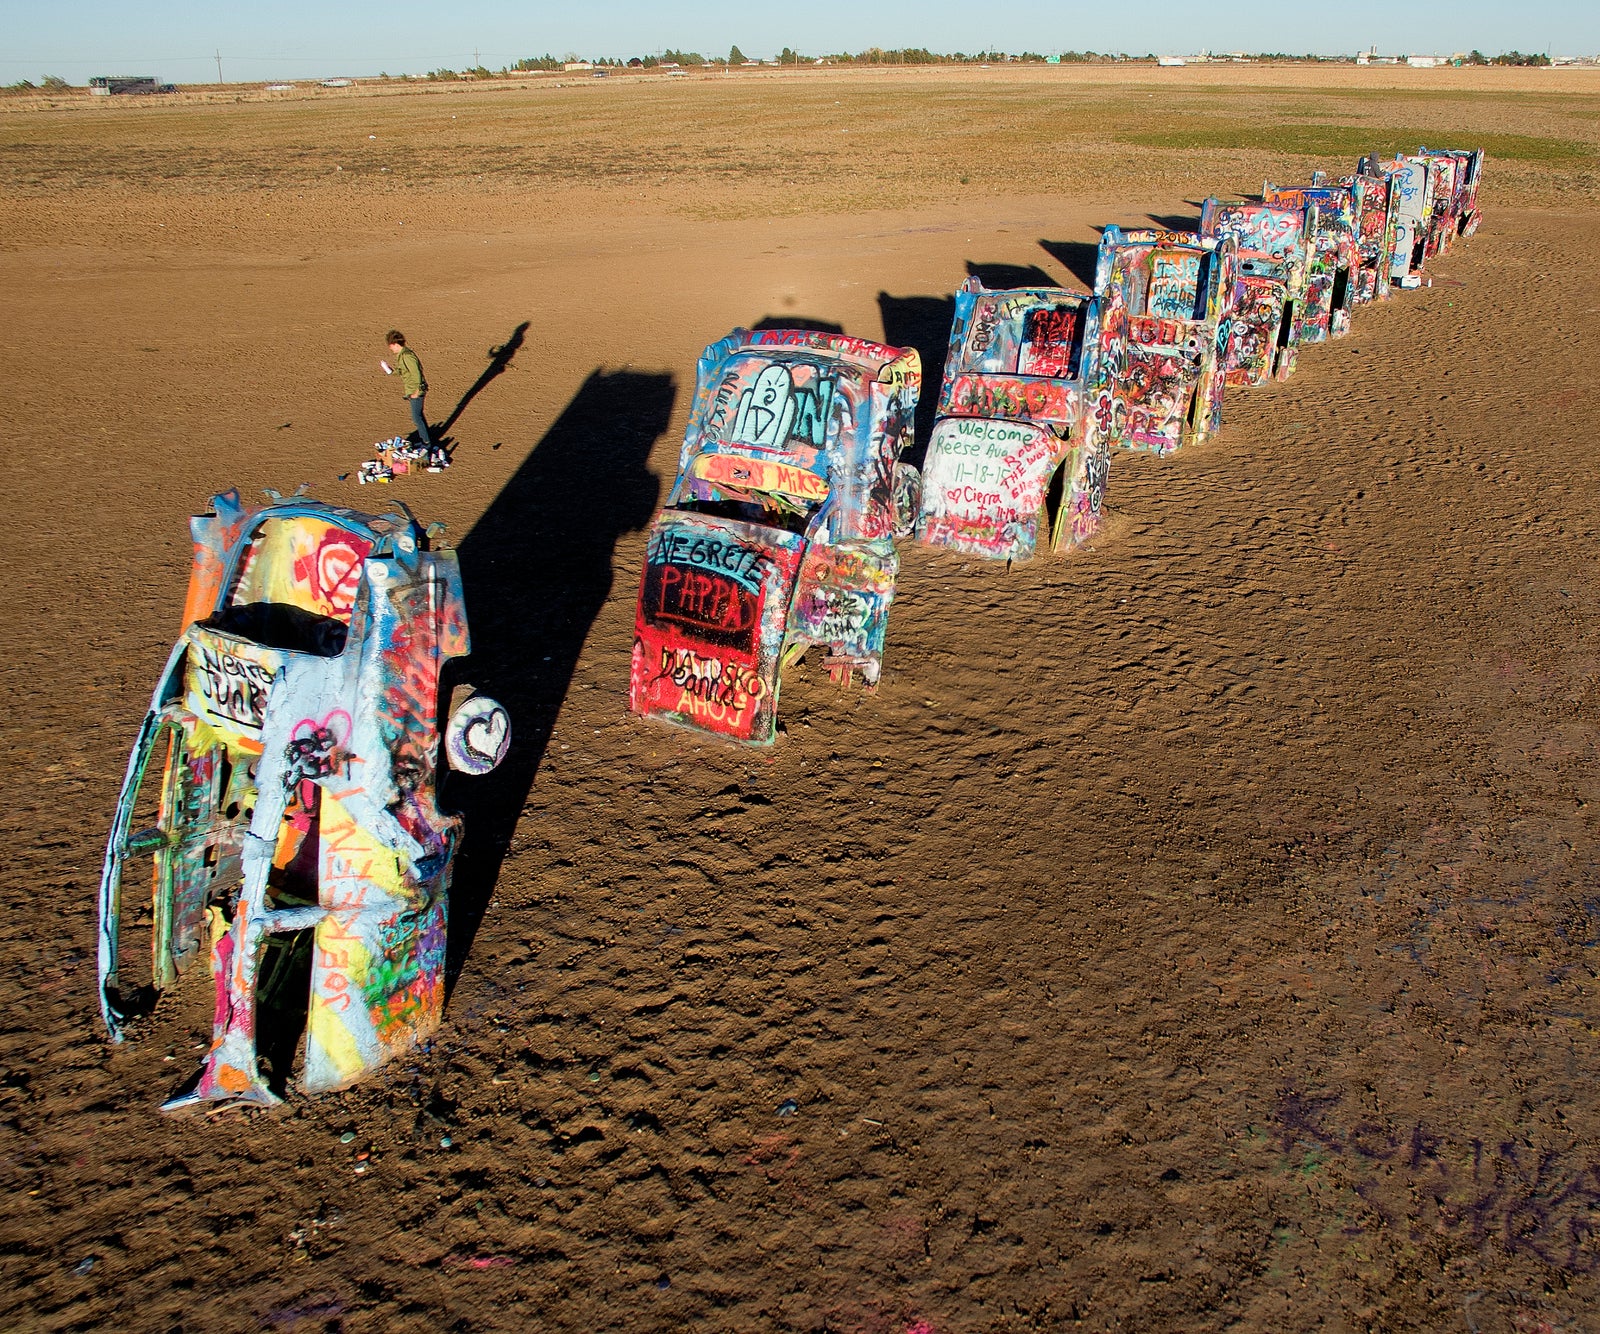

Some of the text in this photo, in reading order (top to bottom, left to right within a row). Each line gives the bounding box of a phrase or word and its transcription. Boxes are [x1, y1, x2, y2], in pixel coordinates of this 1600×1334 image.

[936, 435, 981, 457] Reese
[958, 421, 1034, 447] Welcome
[963, 485, 1002, 505] Cierra
[653, 532, 774, 581] NEGRETE
[660, 566, 743, 628] PAPPA
